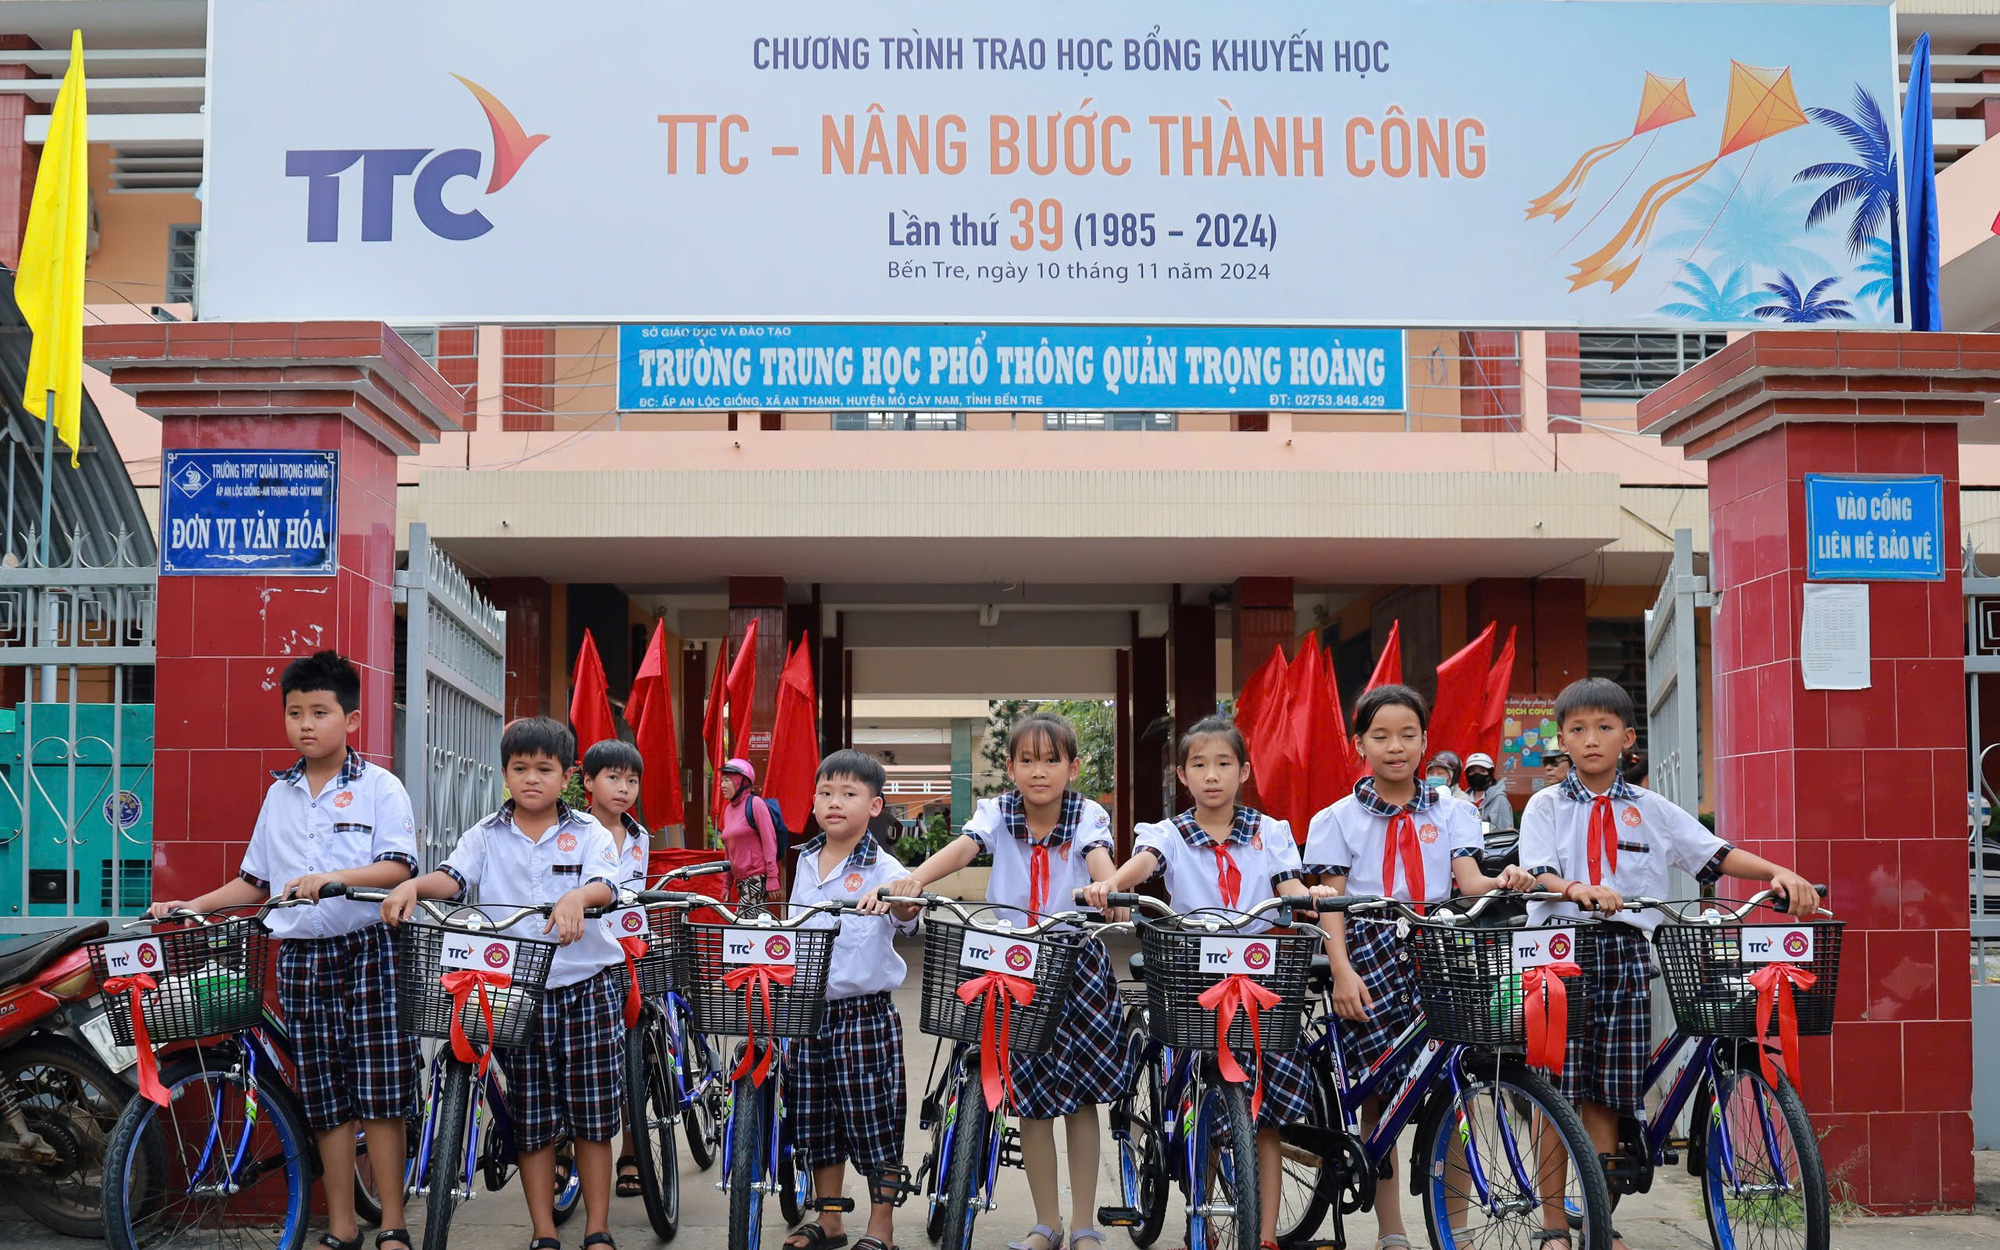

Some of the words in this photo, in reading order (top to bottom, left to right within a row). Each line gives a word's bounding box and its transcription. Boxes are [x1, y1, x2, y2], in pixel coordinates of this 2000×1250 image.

[754, 36, 869, 69] CHƯƠNG
[879, 29, 963, 69] TRÌNH
[973, 38, 1045, 70] TRAO
[1058, 39, 1113, 77] HỌC
[1124, 25, 1200, 71] BỔNG
[1212, 29, 1323, 72] KHUYẾN
[1335, 41, 1389, 79] HỌC
[657, 114, 749, 175] TTC
[822, 103, 967, 175] NÂNG
[989, 98, 1132, 176] BƯỚC
[1149, 98, 1324, 177] THÀNH
[1345, 105, 1486, 179] CÔNG
[285, 148, 494, 242] TTC
[888, 209, 941, 247] Lần
[949, 211, 1000, 247] thứ
[1009, 198, 1063, 252] 39
[1074, 212, 1156, 252] (1985
[1195, 212, 1277, 252] 2024)
[888, 259, 926, 279] Bến
[933, 262, 970, 282] Tre,
[977, 262, 1028, 283] ngày
[1036, 262, 1060, 280] 10
[1066, 262, 1129, 283] tháng
[1137, 262, 1157, 279] 11
[1168, 262, 1213, 280] năm
[1220, 262, 1271, 280] 2024
[642, 326, 659, 338] SỞ
[661, 326, 689, 338] GIÁO
[693, 327, 717, 339] DỤC
[721, 326, 738, 337] VÀ
[739, 326, 764, 337] ĐÀO
[769, 327, 792, 338] TẠO
[639, 339, 752, 387] TRƯỜNG
[760, 347, 853, 386] TRUNG
[862, 346, 921, 394] HỌC
[929, 330, 989, 386] PHỔ
[997, 337, 1094, 386] THÔNG
[1102, 335, 1178, 396] QUẢN
[1185, 346, 1282, 394] TRỌNG
[1289, 338, 1385, 387] HOÀNG
[639, 397, 659, 407] ĐC:
[661, 394, 676, 407] ẤP
[679, 397, 695, 407] AN
[698, 395, 721, 408] LỘC
[765, 394, 780, 406] XÃ
[783, 396, 799, 406] AN
[802, 396, 843, 408] THẠNH,
[846, 394, 885, 407] HUYỆN
[888, 393, 906, 406] MỎ
[908, 393, 931, 406] CÀY
[934, 395, 963, 407] NAM,
[965, 392, 991, 406] TỈNH
[994, 391, 1018, 406] BẾN
[1021, 395, 1043, 406] TRE
[1269, 394, 1291, 406] ĐT:
[1295, 394, 1385, 407] 02753.848.429
[212, 459, 241, 479] TRƯỜNG
[241, 463, 259, 479] THPT
[259, 458, 279, 479] QUẢN
[279, 463, 303, 481] TRỌNG
[303, 460, 329, 479] HOÀNG
[224, 486, 232, 497] AN
[311, 486, 323, 497] NAM
[1836, 491, 1867, 521] VÀO
[1870, 488, 1913, 521] CỔNG
[171, 513, 211, 550] ĐƠN
[215, 518, 237, 555] VỊ
[241, 509, 281, 549] VĂN
[285, 509, 326, 550] HÓA
[1818, 530, 1851, 559] LIÊN
[1854, 530, 1876, 564] HỆ
[1878, 528, 1910, 560] BẢO
[1912, 531, 1933, 565] VỆ
[448, 947, 468, 960] TTC
[729, 944, 750, 955] TTC
[968, 947, 989, 961] TTC
[1518, 946, 1537, 958] TTC
[1748, 942, 1769, 953] TTC
[111, 957, 128, 968] TTC
[1206, 952, 1228, 964] TTC
